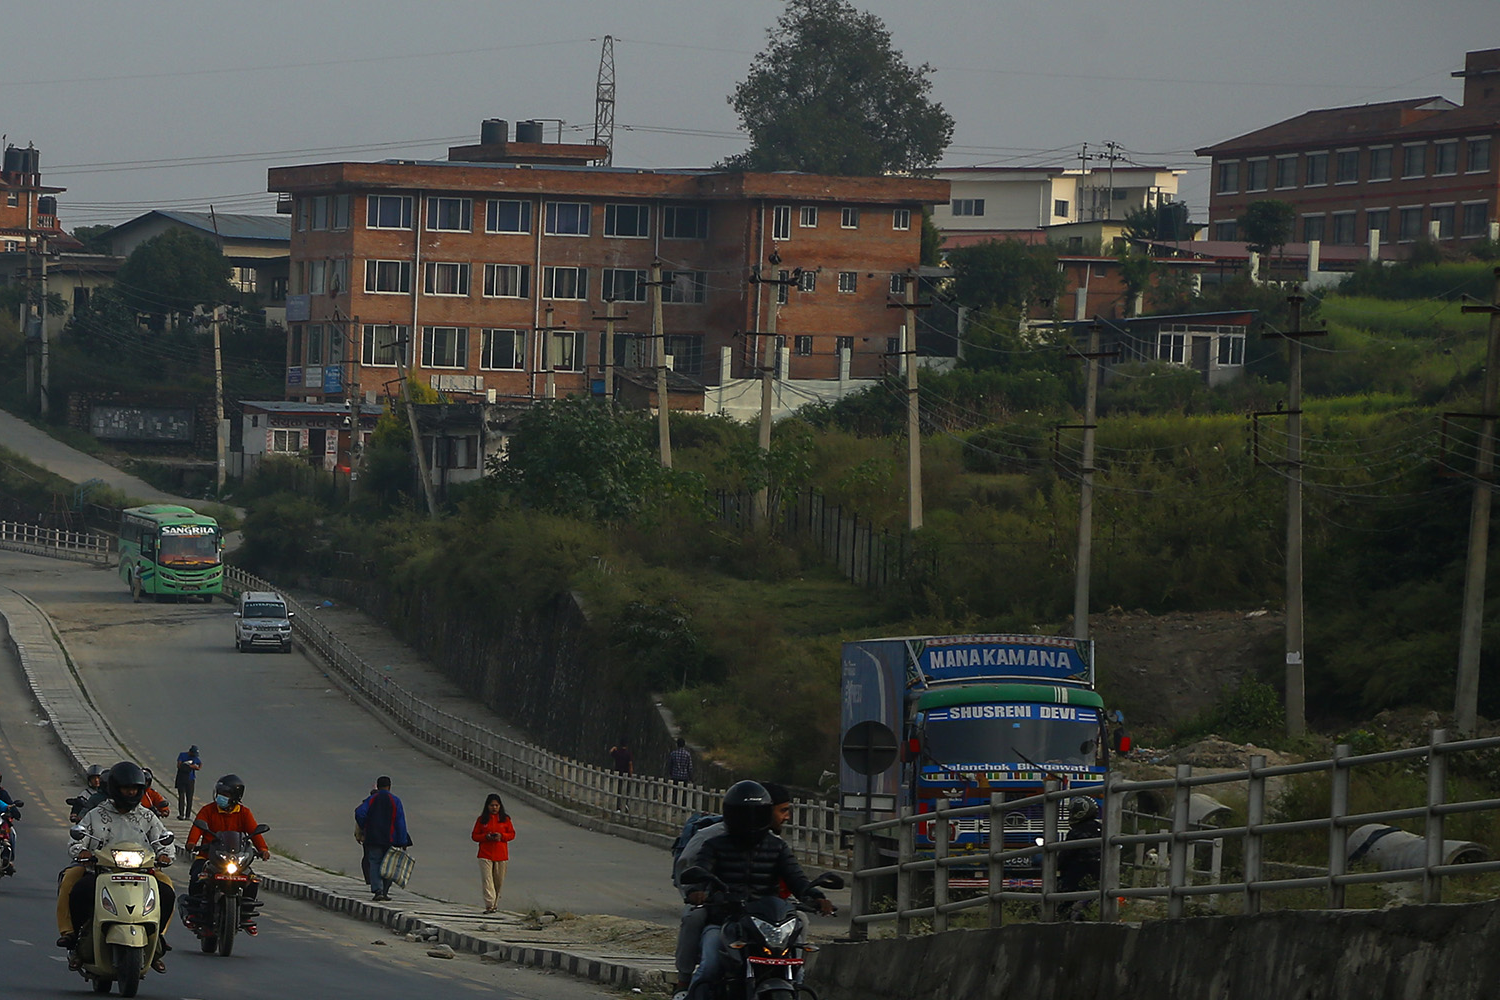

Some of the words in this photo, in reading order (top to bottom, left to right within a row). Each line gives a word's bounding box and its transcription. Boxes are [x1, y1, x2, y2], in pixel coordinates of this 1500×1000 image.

[929, 648, 1072, 670] MANAKAMANA
[949, 705, 1032, 720] SHUSRENI
[1039, 706, 1076, 720] DEVI
